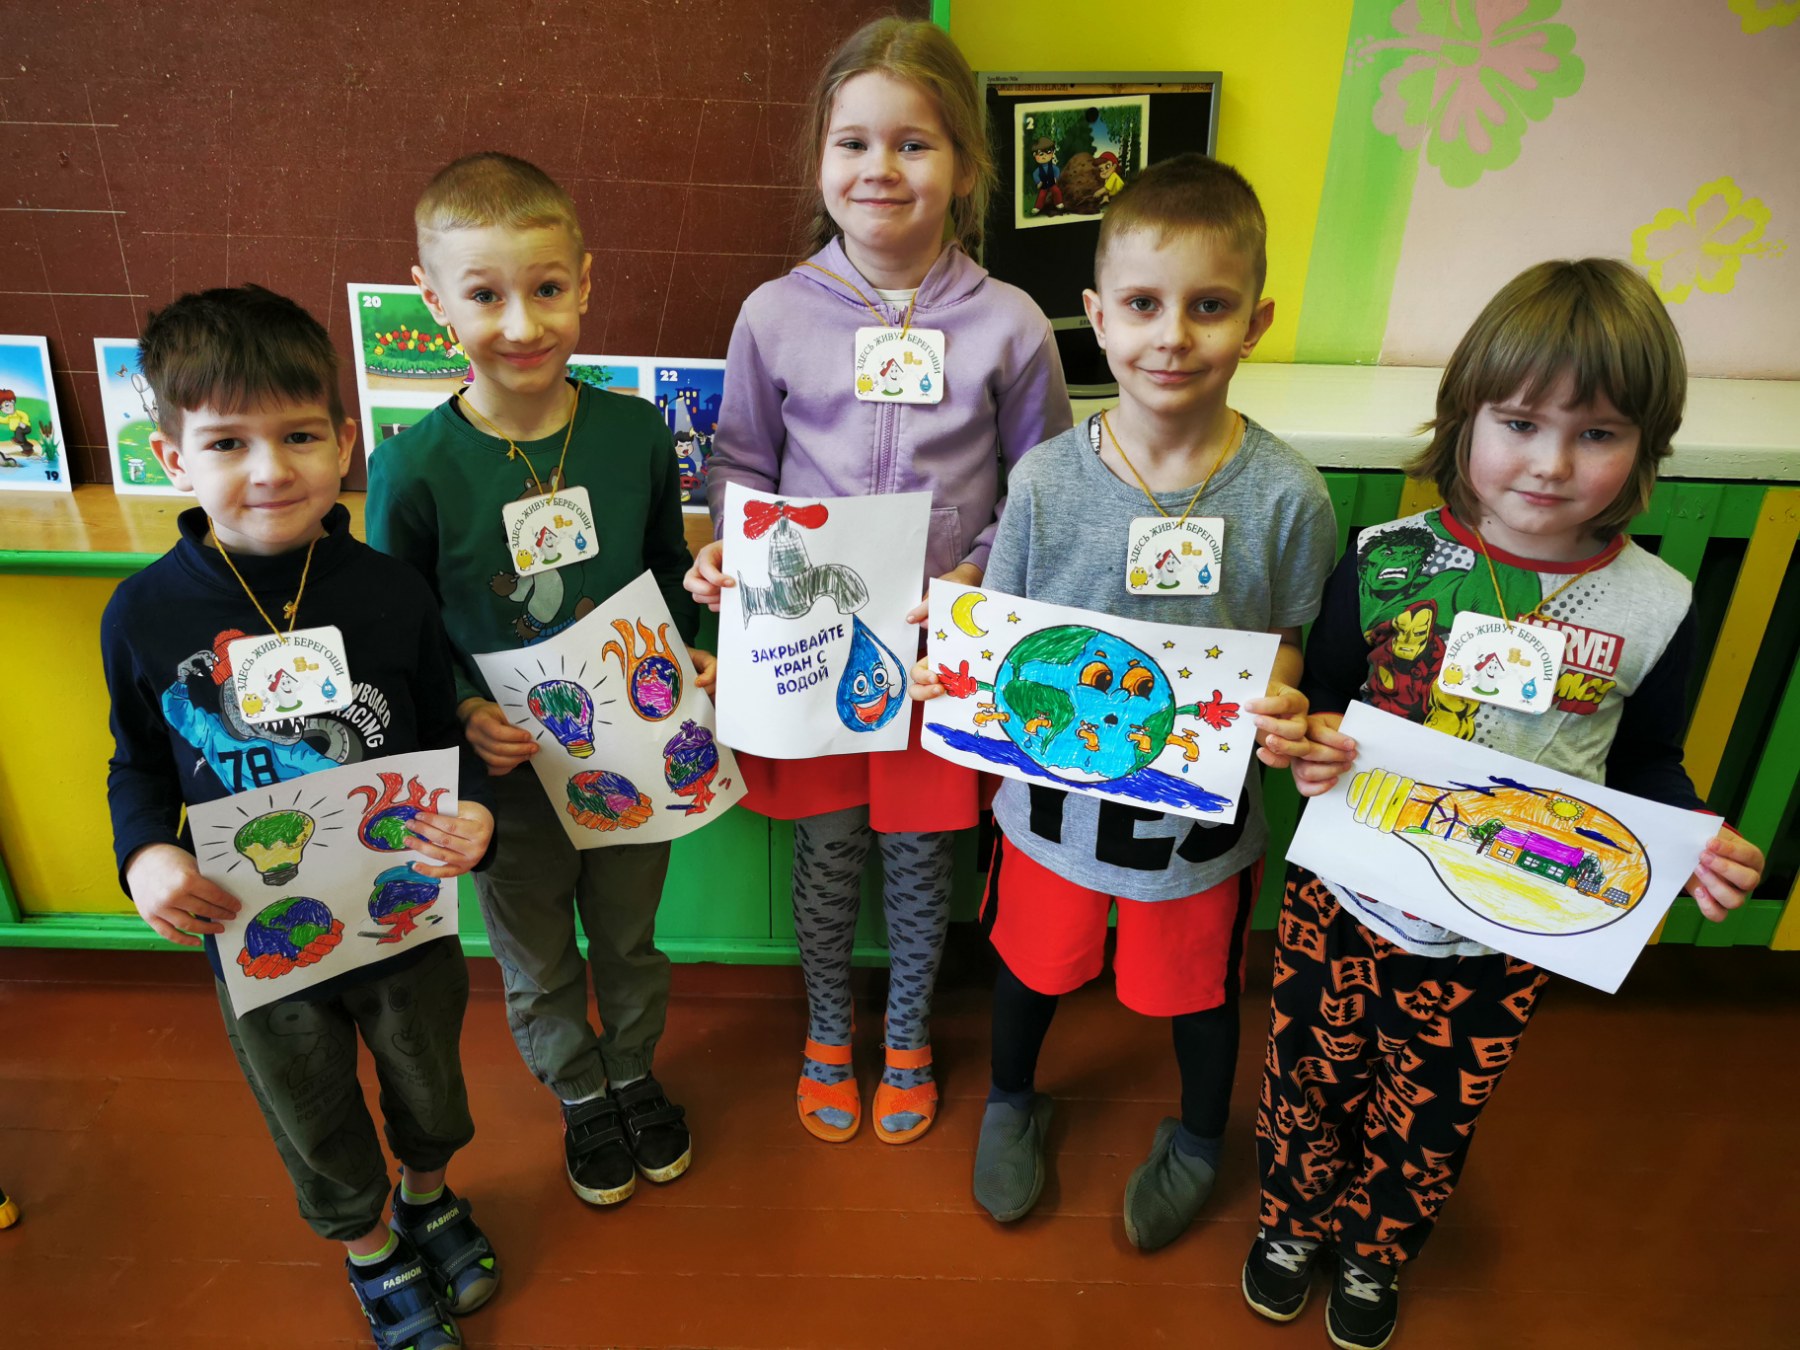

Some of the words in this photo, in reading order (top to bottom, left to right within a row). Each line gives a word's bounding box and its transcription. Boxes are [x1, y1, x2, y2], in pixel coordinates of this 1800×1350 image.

[1025, 116, 1036, 130] 2
[362, 295, 382, 309] 20
[857, 343, 875, 371] ЗДЕСЬ
[660, 370, 679, 382] 22
[44, 470, 60, 481] 19
[512, 518, 525, 550] ЗДЕСЬ
[1130, 535, 1151, 564] ЗДЕСЬ
[751, 623, 845, 663] ЗАКРЫВАЙТЕ
[1447, 631, 1475, 660] ЗДЕСЬ
[237, 657, 255, 692] ЗДЕСЬ
[774, 655, 812, 678] КРАН
[776, 664, 829, 695] ВОДОЙ
[217, 746, 280, 795] 78
[426, 1206, 461, 1233] FASHION
[383, 1265, 423, 1290] FASHION
